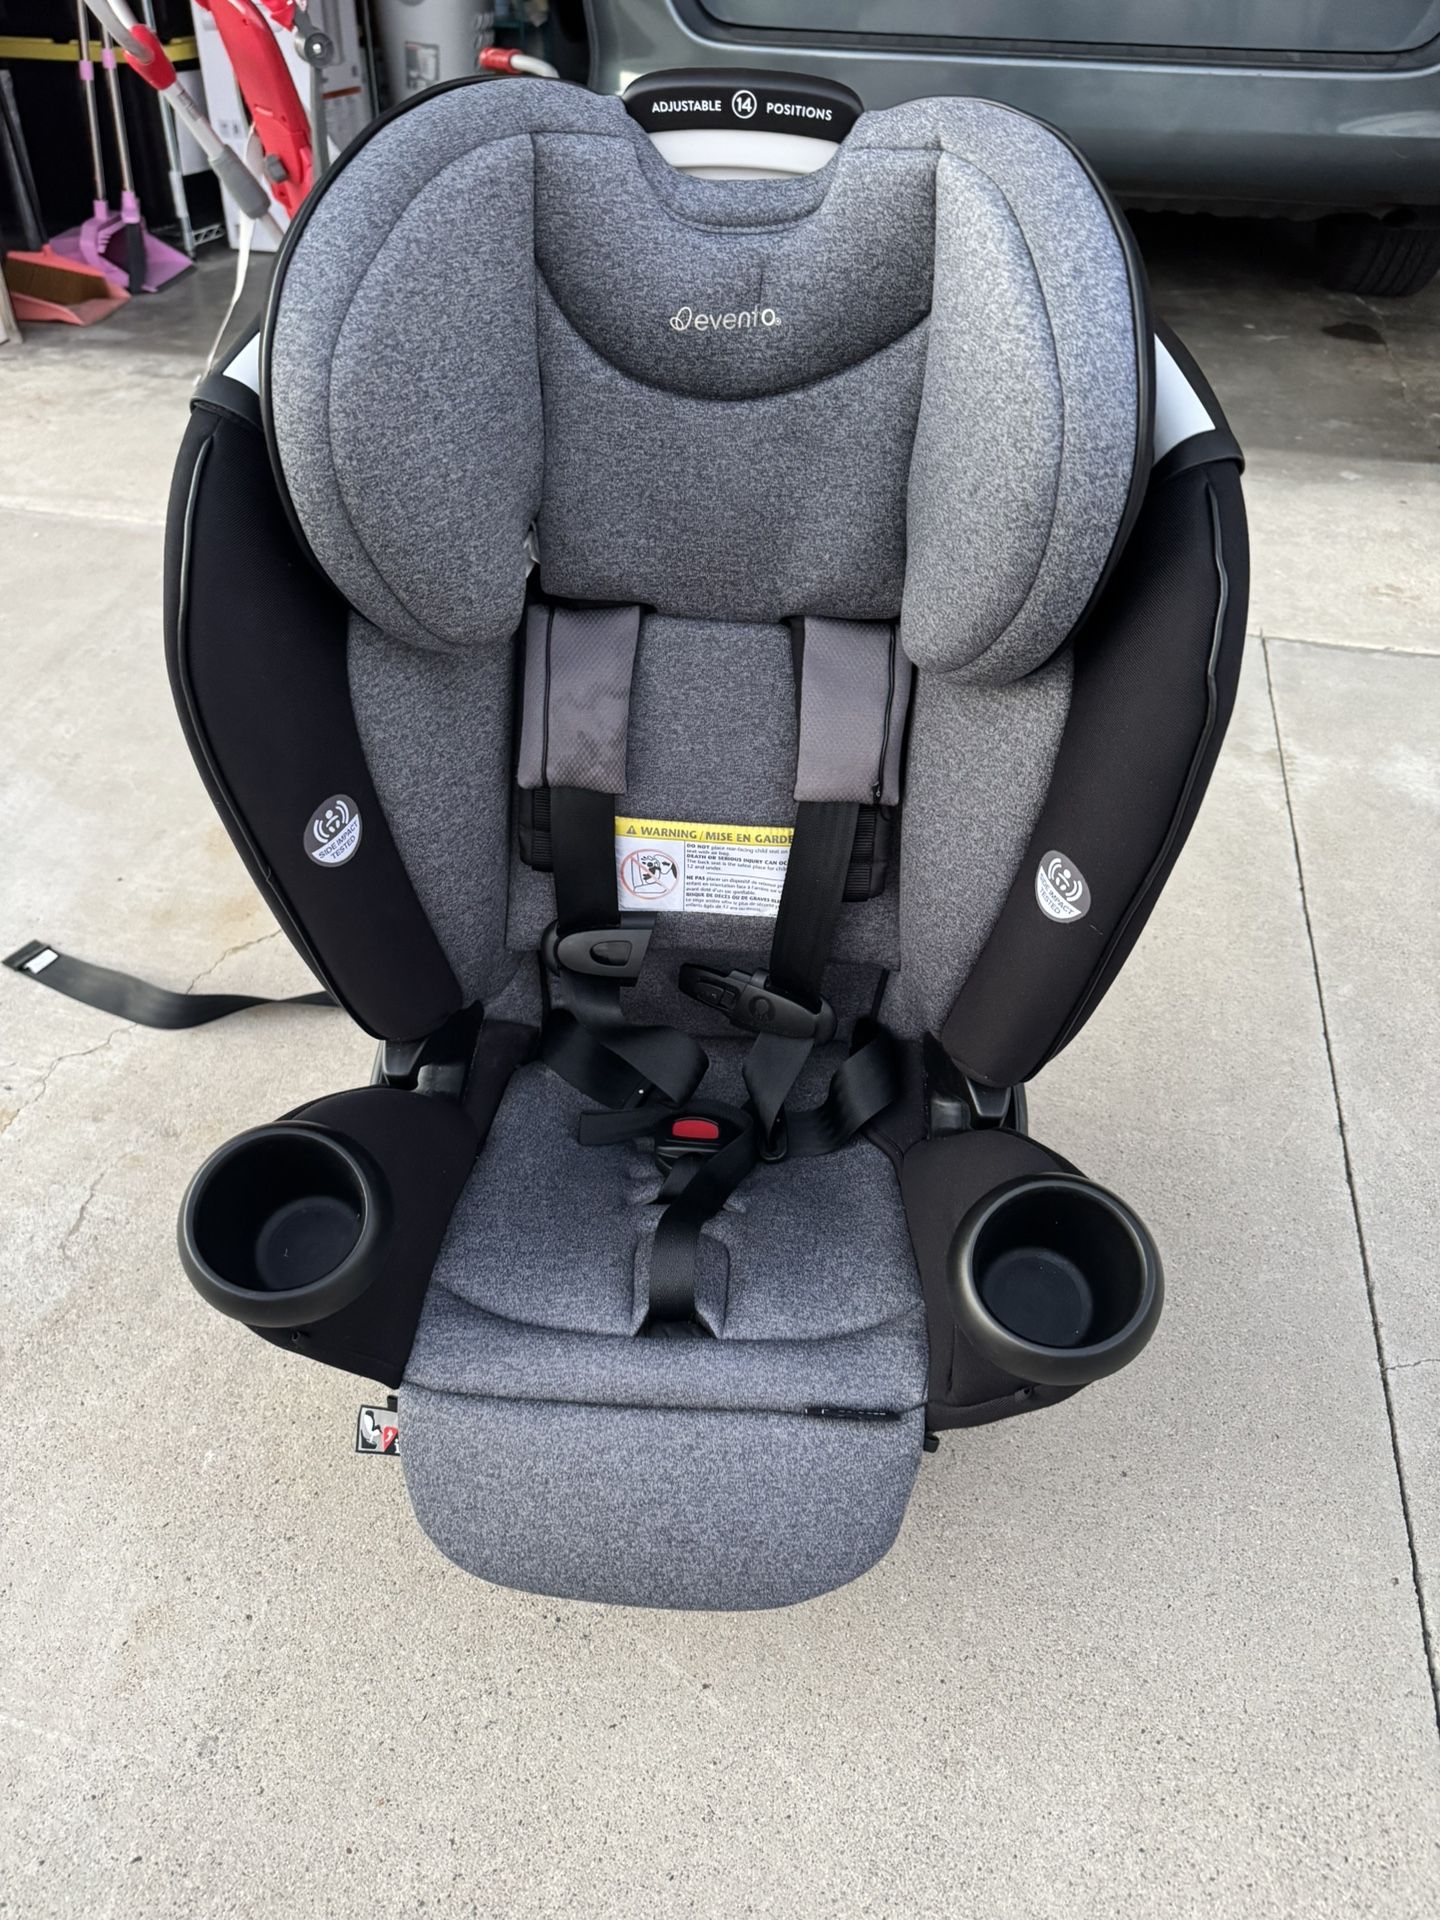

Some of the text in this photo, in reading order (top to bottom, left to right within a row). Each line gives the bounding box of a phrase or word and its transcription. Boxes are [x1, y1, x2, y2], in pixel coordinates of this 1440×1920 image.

[652, 97, 833, 121] ADJUSTABLE 14 POSITIONS
[319, 821, 358, 858] SIDE IMPACT
[331, 835, 356, 859] TESTED
[641, 827, 697, 839] WARNING
[705, 831, 733, 842] MISE
[736, 833, 751, 843] EN
[1040, 873, 1074, 914] SIDE IMPACT
[1040, 888, 1061, 914] TESTED
